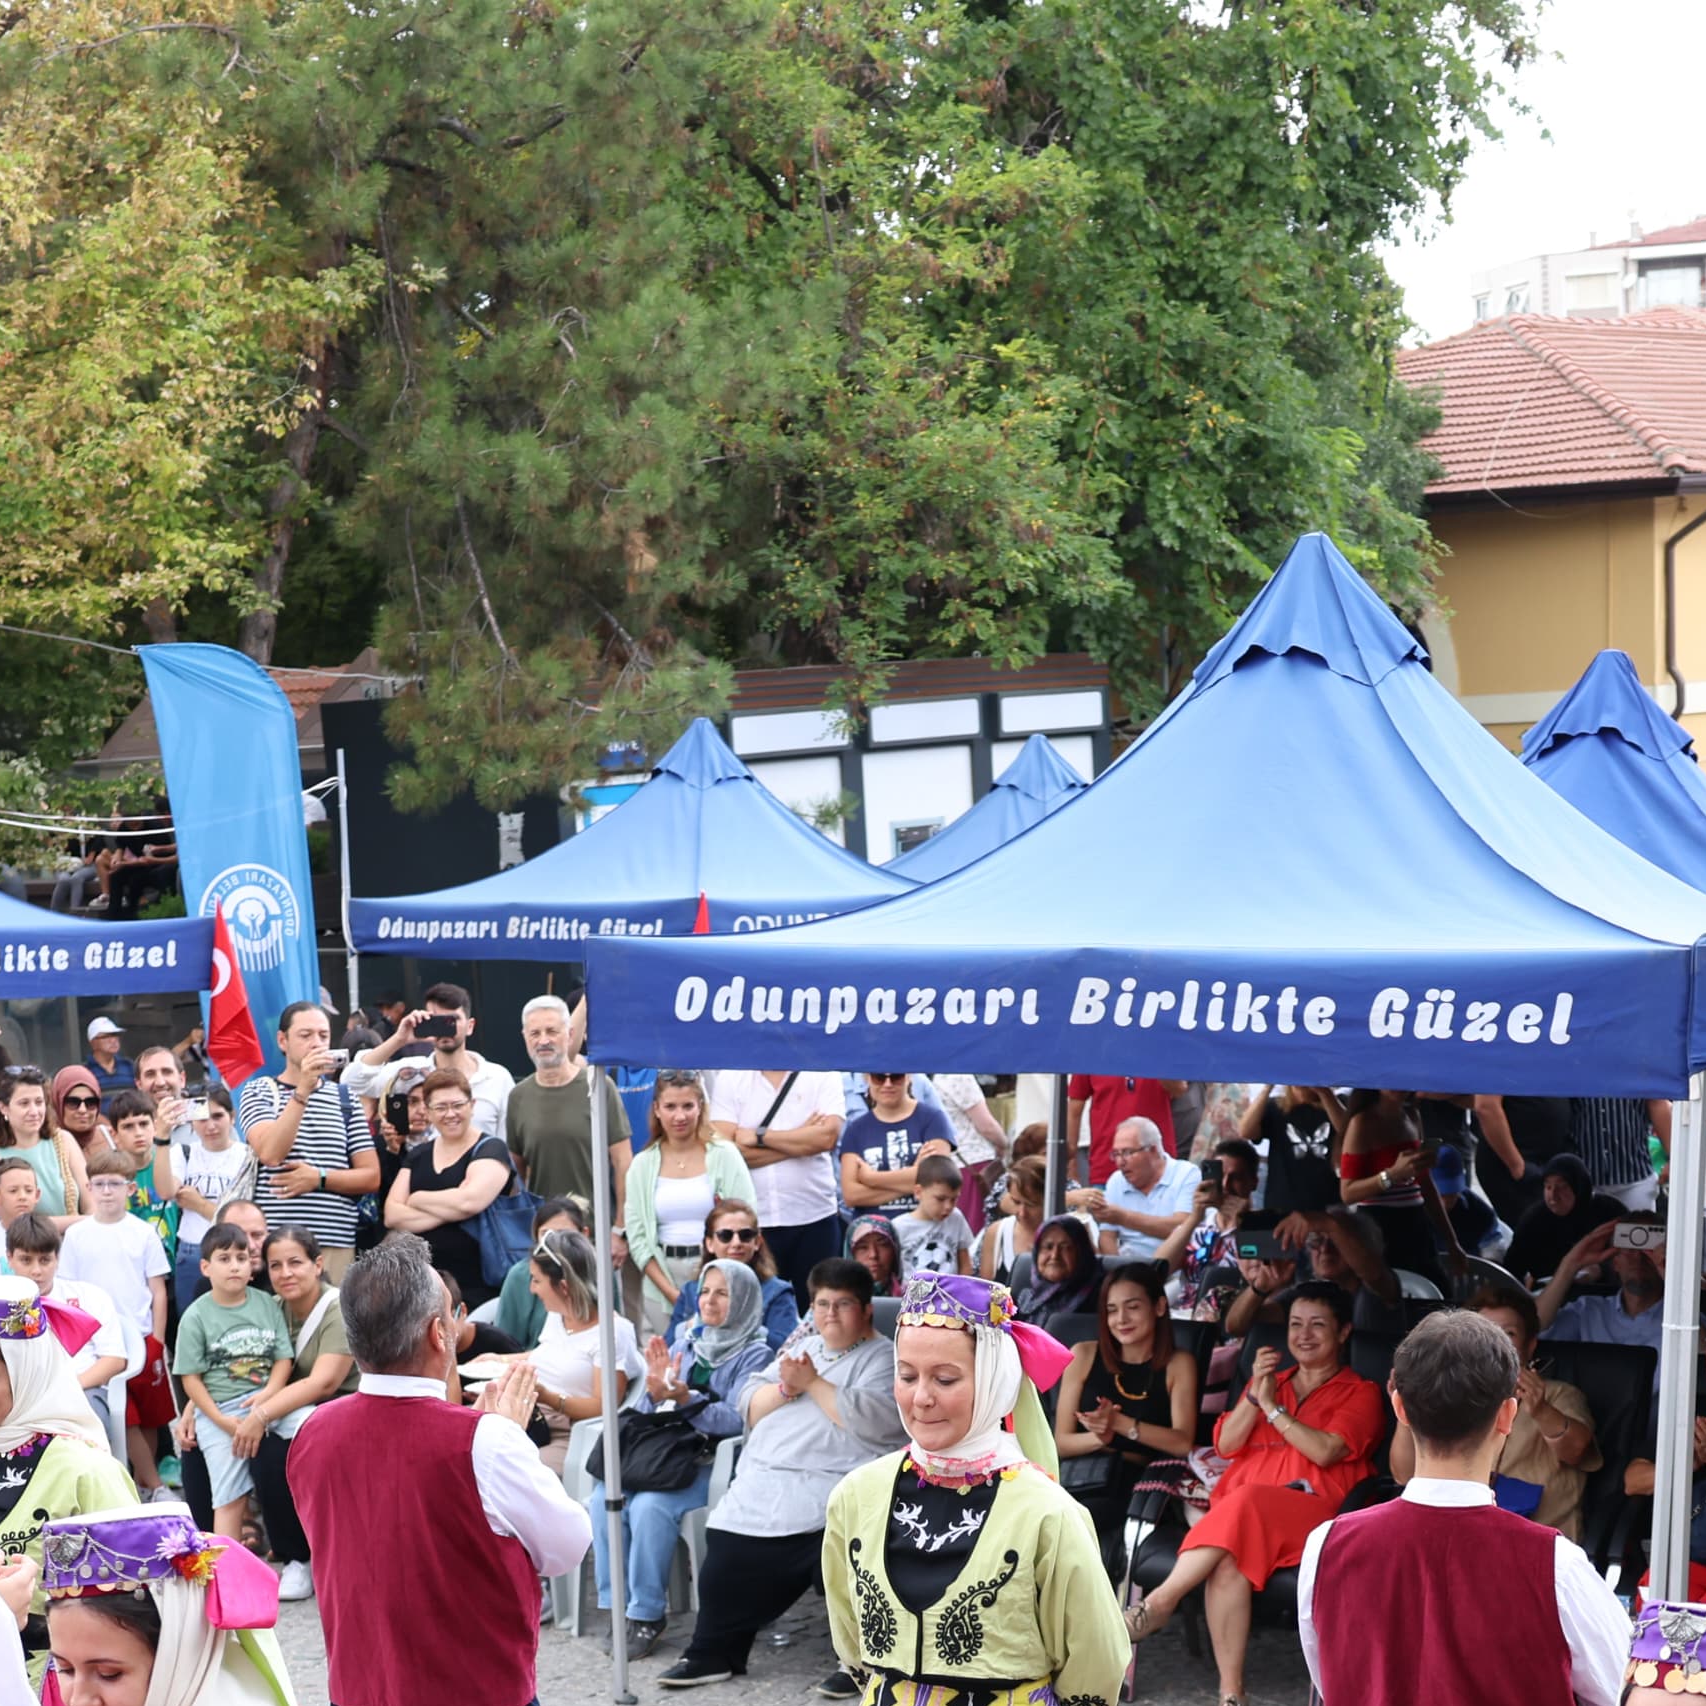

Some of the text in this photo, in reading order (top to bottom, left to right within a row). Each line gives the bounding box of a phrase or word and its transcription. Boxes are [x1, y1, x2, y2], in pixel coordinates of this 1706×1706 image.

[377, 915, 499, 944] Odunpazarı
[506, 916, 590, 941] Birlikte
[83, 939, 177, 970] Güzel
[674, 975, 1574, 1045] Odunpazarı Birlikte Güzel
